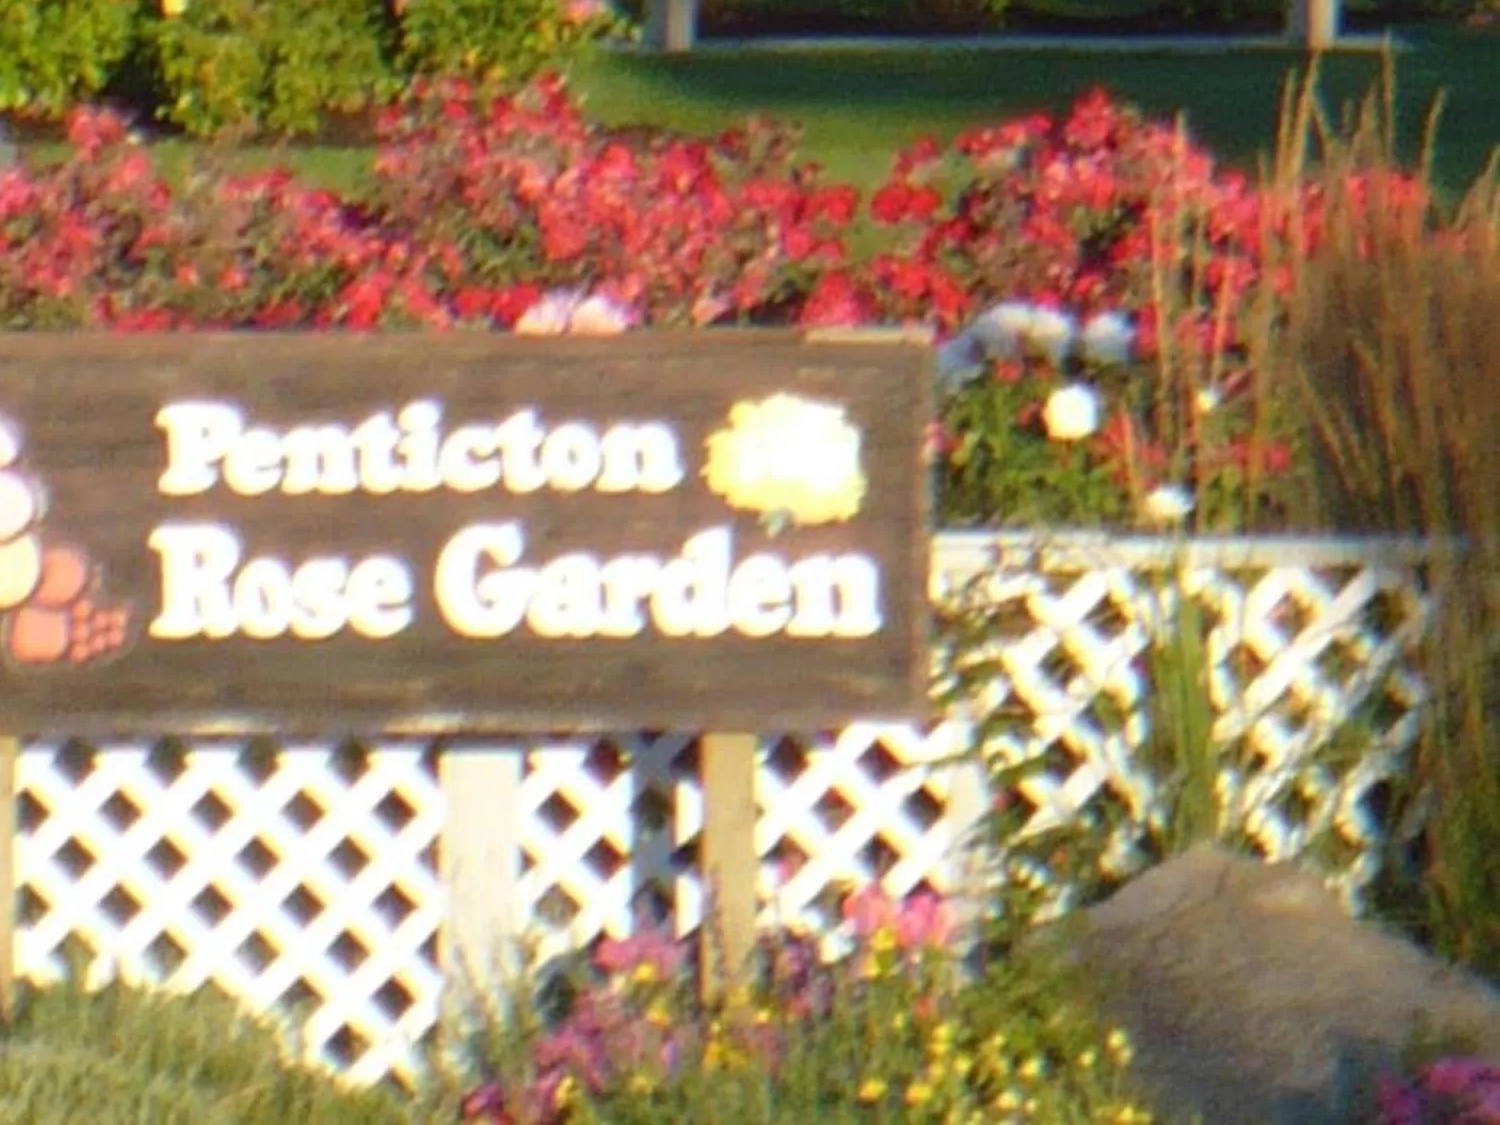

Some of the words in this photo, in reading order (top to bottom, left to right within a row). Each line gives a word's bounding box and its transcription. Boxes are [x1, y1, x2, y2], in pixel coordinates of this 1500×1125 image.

[155, 396, 687, 496] Penticton
[147, 518, 415, 640] Rose
[433, 518, 883, 640] Garden
